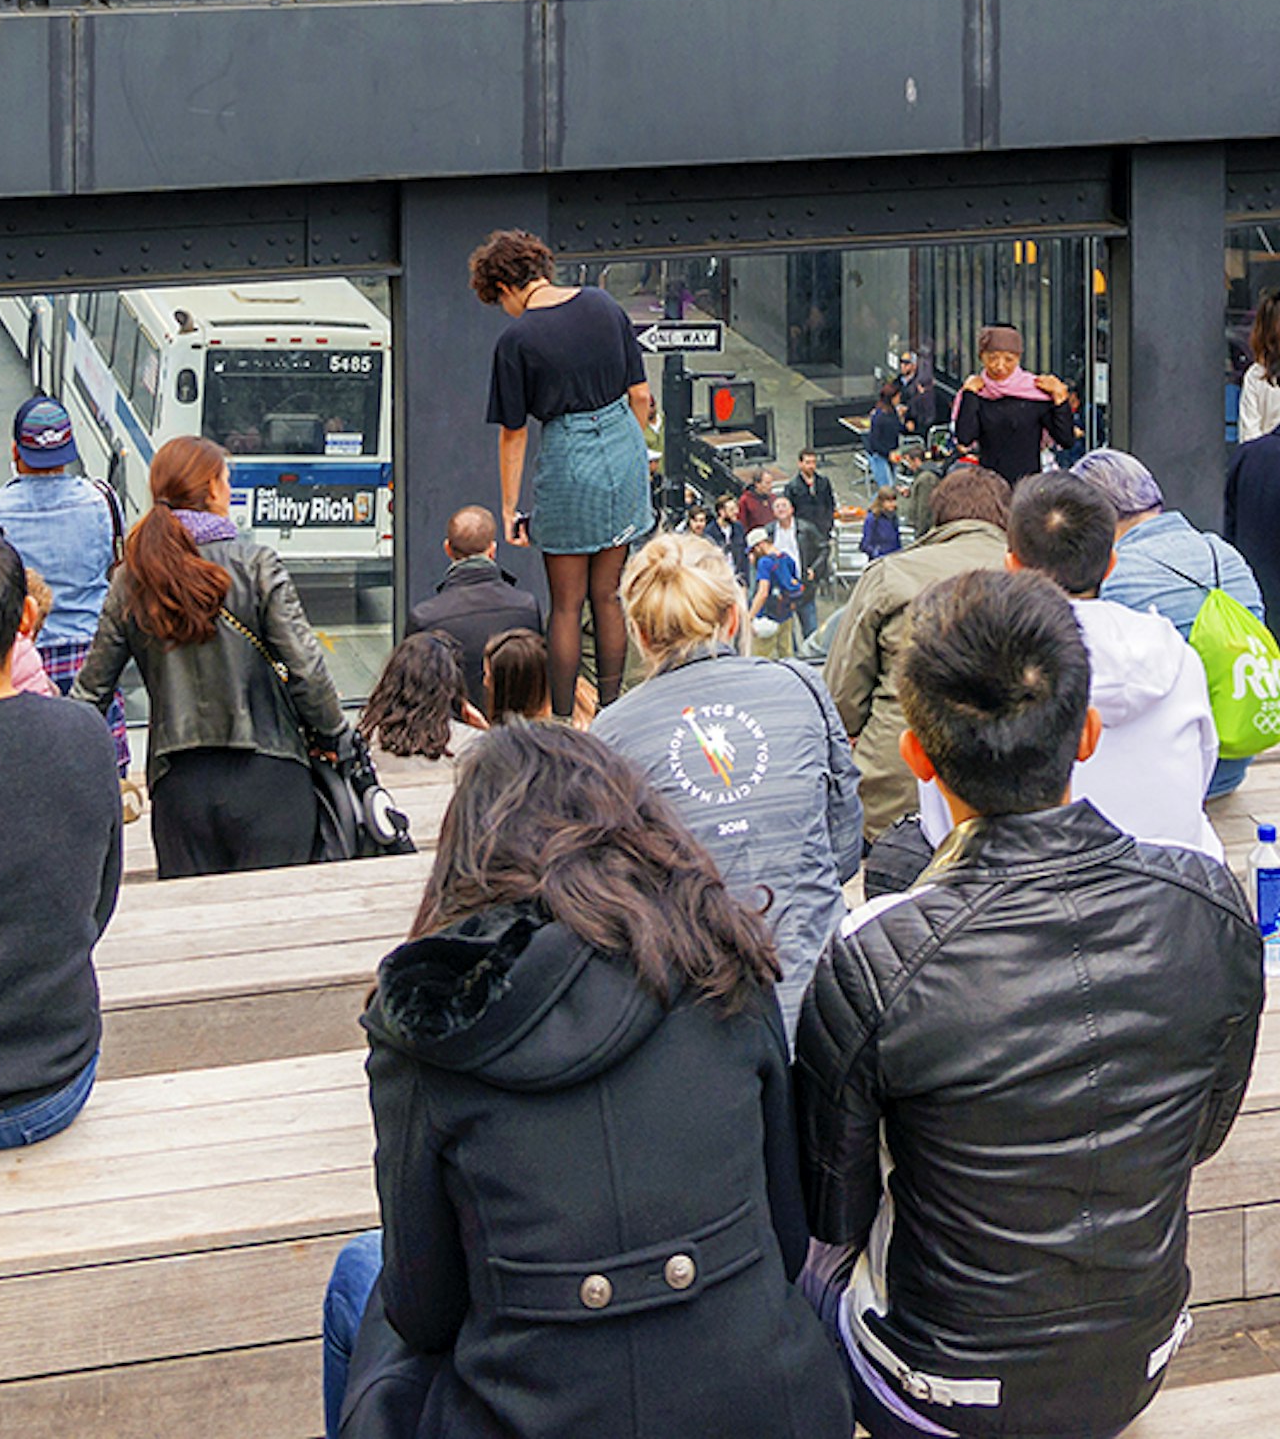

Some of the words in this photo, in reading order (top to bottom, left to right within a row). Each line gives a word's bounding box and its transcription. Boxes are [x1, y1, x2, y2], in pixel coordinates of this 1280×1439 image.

[683, 332, 710, 343] WAY
[328, 355, 373, 373] 5485
[257, 487, 277, 497] Get
[256, 496, 309, 526] Filthy
[310, 496, 354, 522] Rich
[701, 704, 735, 718] TCS
[737, 711, 765, 739] NEW
[669, 726, 713, 803] MARATHON
[749, 741, 768, 785] YORK
[716, 784, 751, 805] CITY
